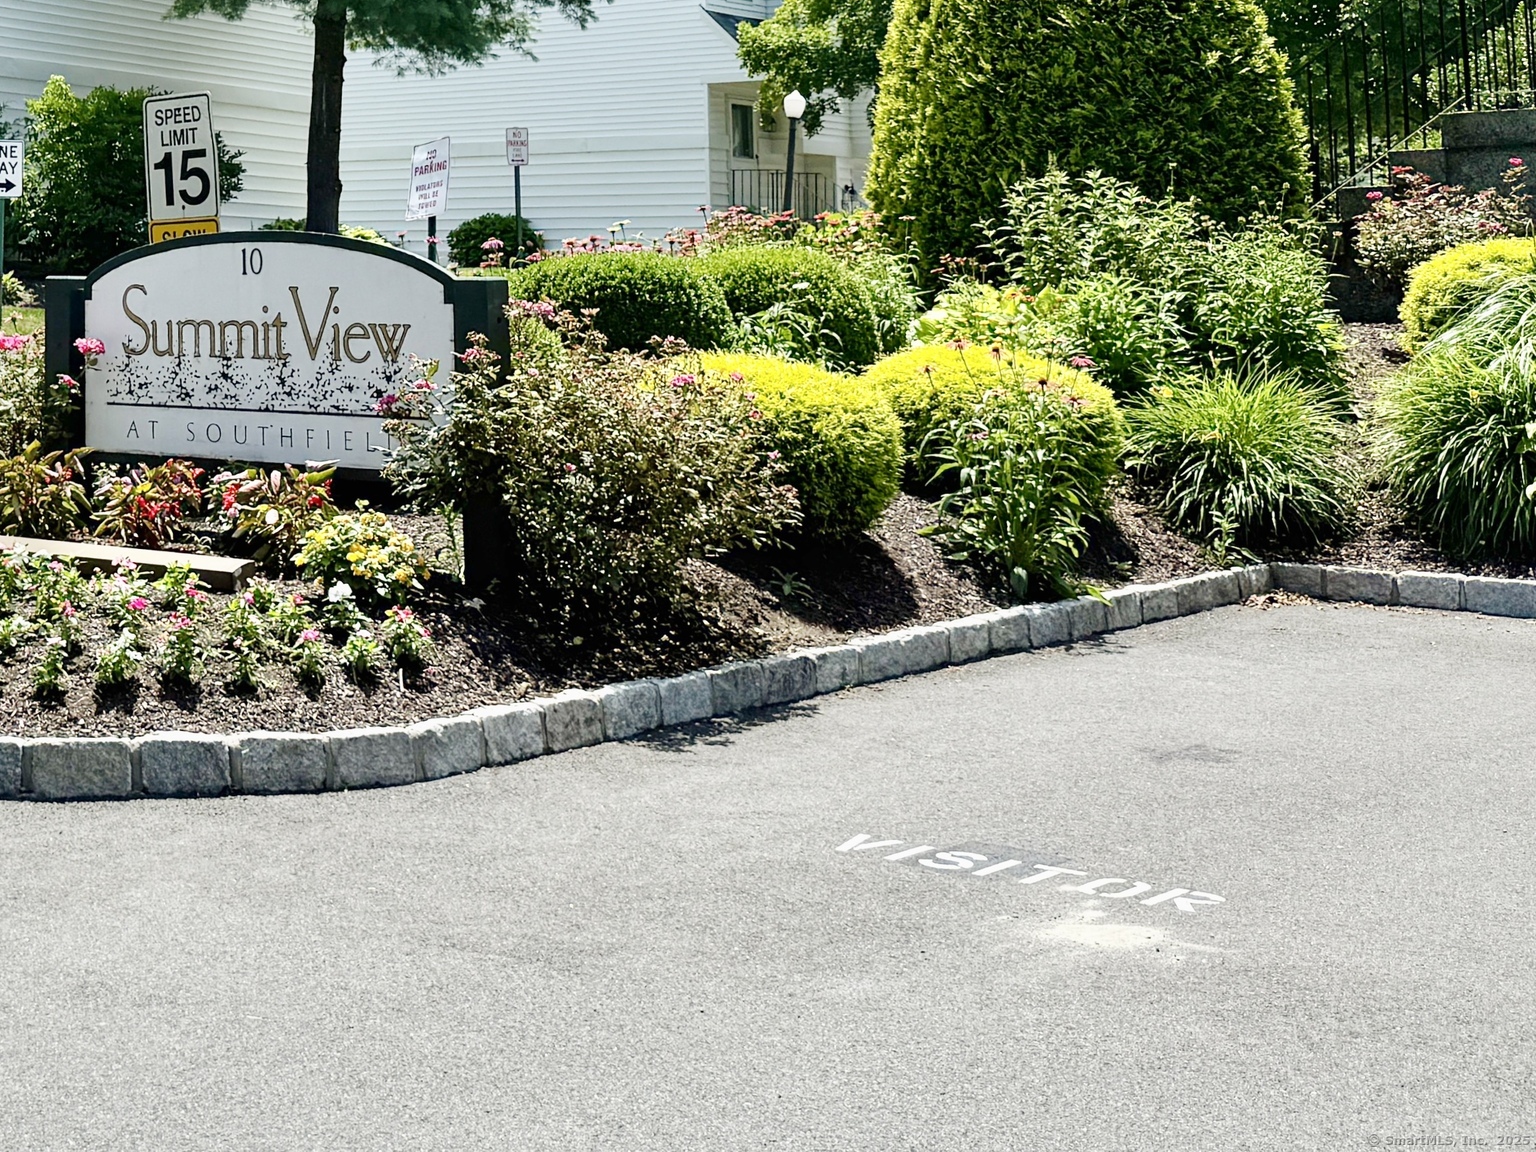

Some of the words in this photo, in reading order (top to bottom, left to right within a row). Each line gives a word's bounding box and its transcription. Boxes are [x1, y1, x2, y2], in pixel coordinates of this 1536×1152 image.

[154, 105, 201, 126] SPEED
[160, 127, 198, 147] LIMIT
[426, 149, 437, 160] NO
[153, 148, 211, 207] 15
[414, 160, 447, 176] PARKING
[241, 248, 263, 275] 10
[122, 284, 291, 360] Summit
[288, 286, 411, 363] View
[126, 420, 158, 439] AT
[835, 833, 1226, 912] VISITOR
